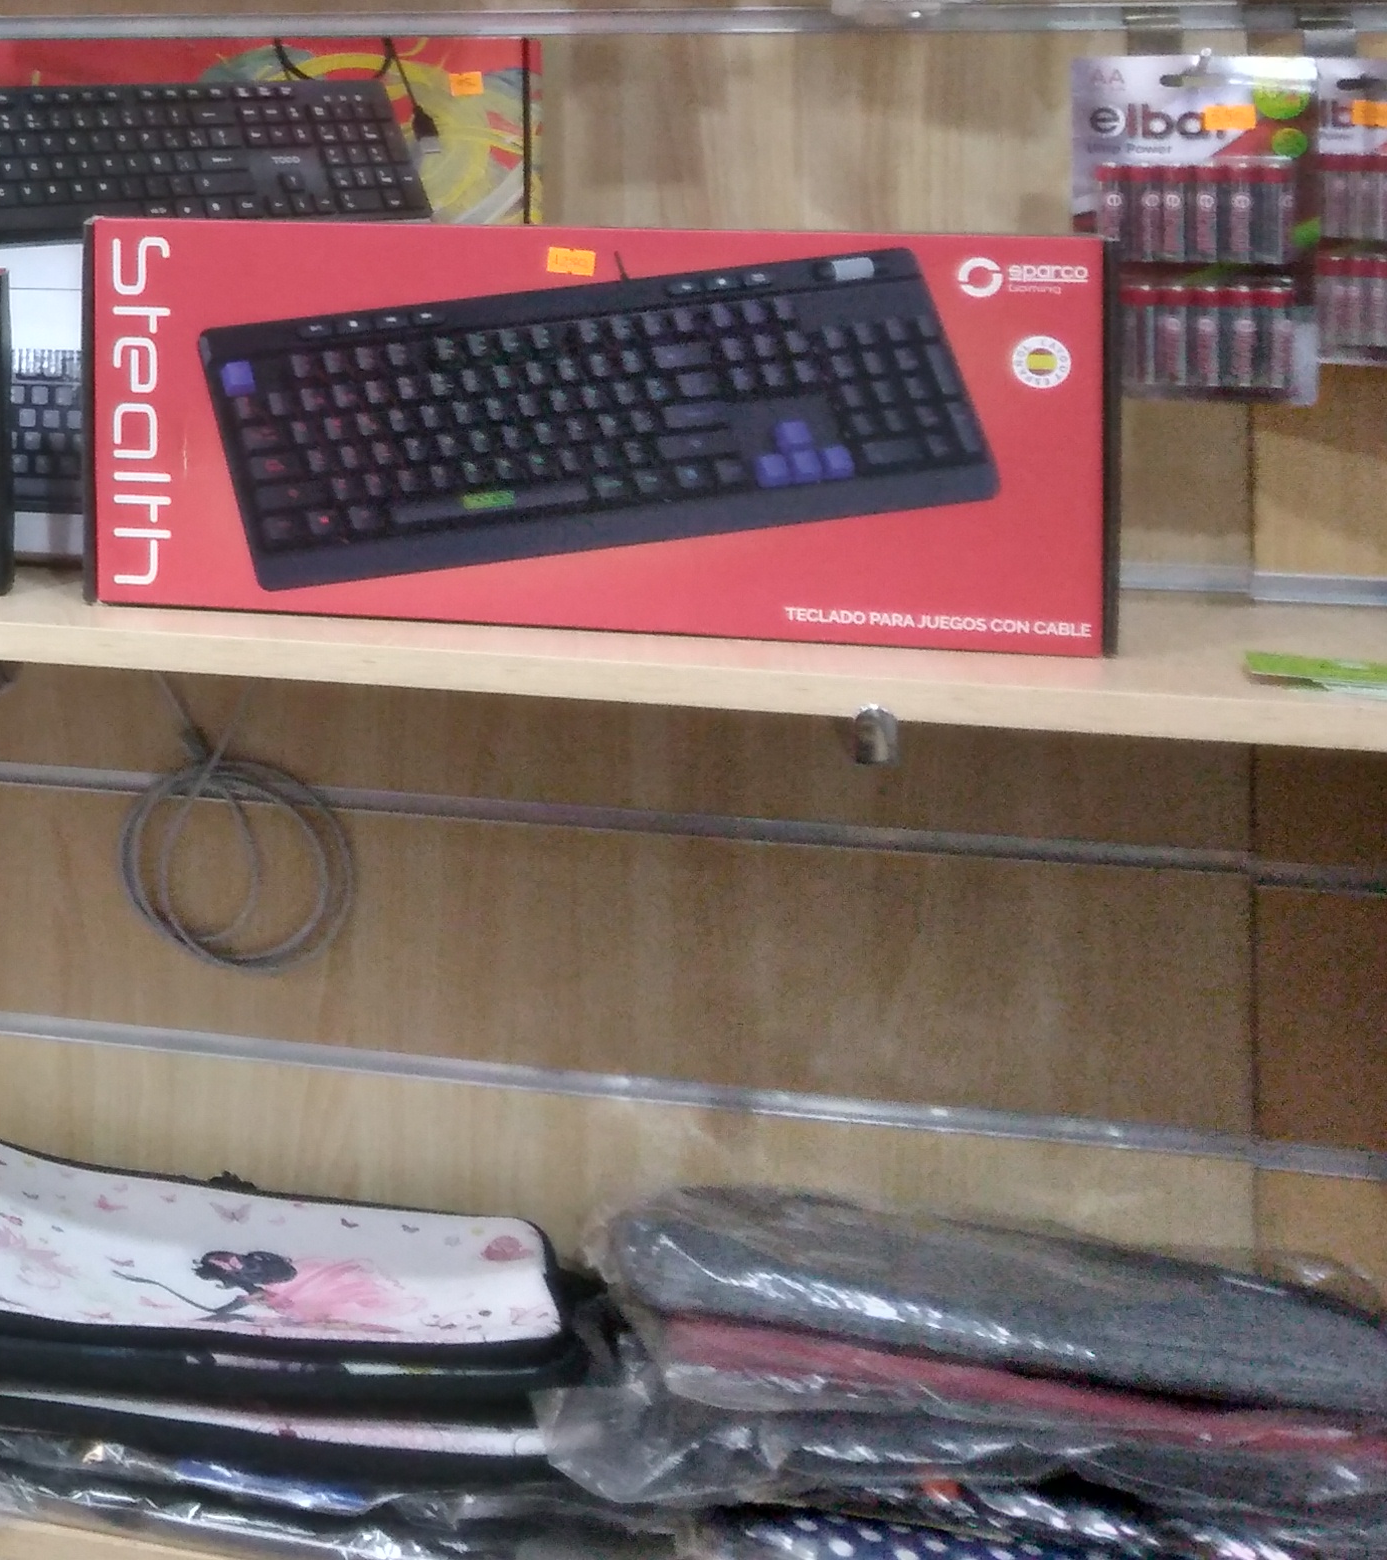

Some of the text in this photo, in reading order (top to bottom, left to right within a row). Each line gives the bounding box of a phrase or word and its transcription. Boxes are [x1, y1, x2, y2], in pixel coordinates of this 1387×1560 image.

[1090, 70, 1126, 86] AA
[1125, 142, 1173, 156] Power
[1007, 263, 1089, 283] sparco
[112, 236, 172, 586] Stealth
[784, 605, 1093, 640] TECLADO PARA JUEGOS CON CABLE
